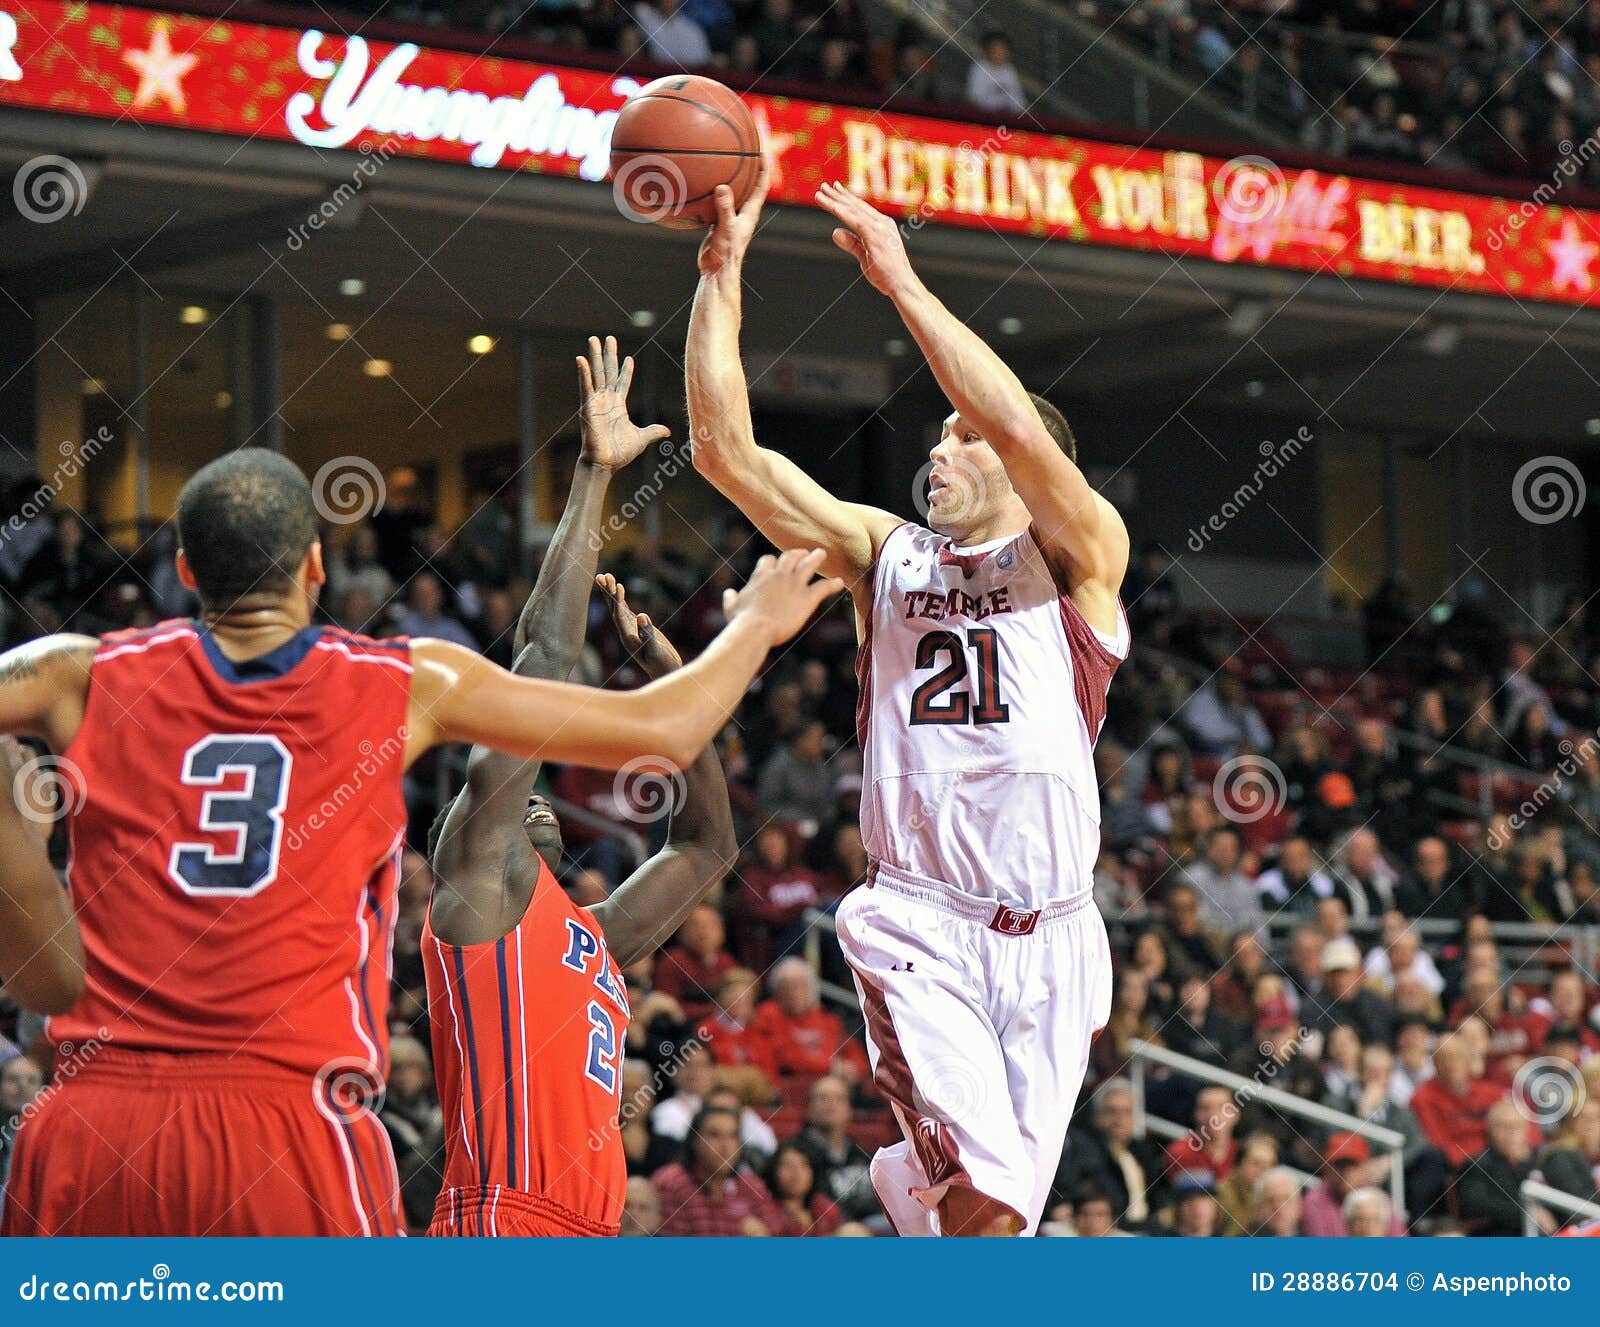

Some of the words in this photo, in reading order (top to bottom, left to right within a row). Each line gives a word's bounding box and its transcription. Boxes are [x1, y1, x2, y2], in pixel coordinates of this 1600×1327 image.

[844, 122, 1079, 228] RETHINK
[903, 587, 1013, 622] TEMPLE
[909, 628, 1010, 725] 21
[168, 733, 294, 898] 3
